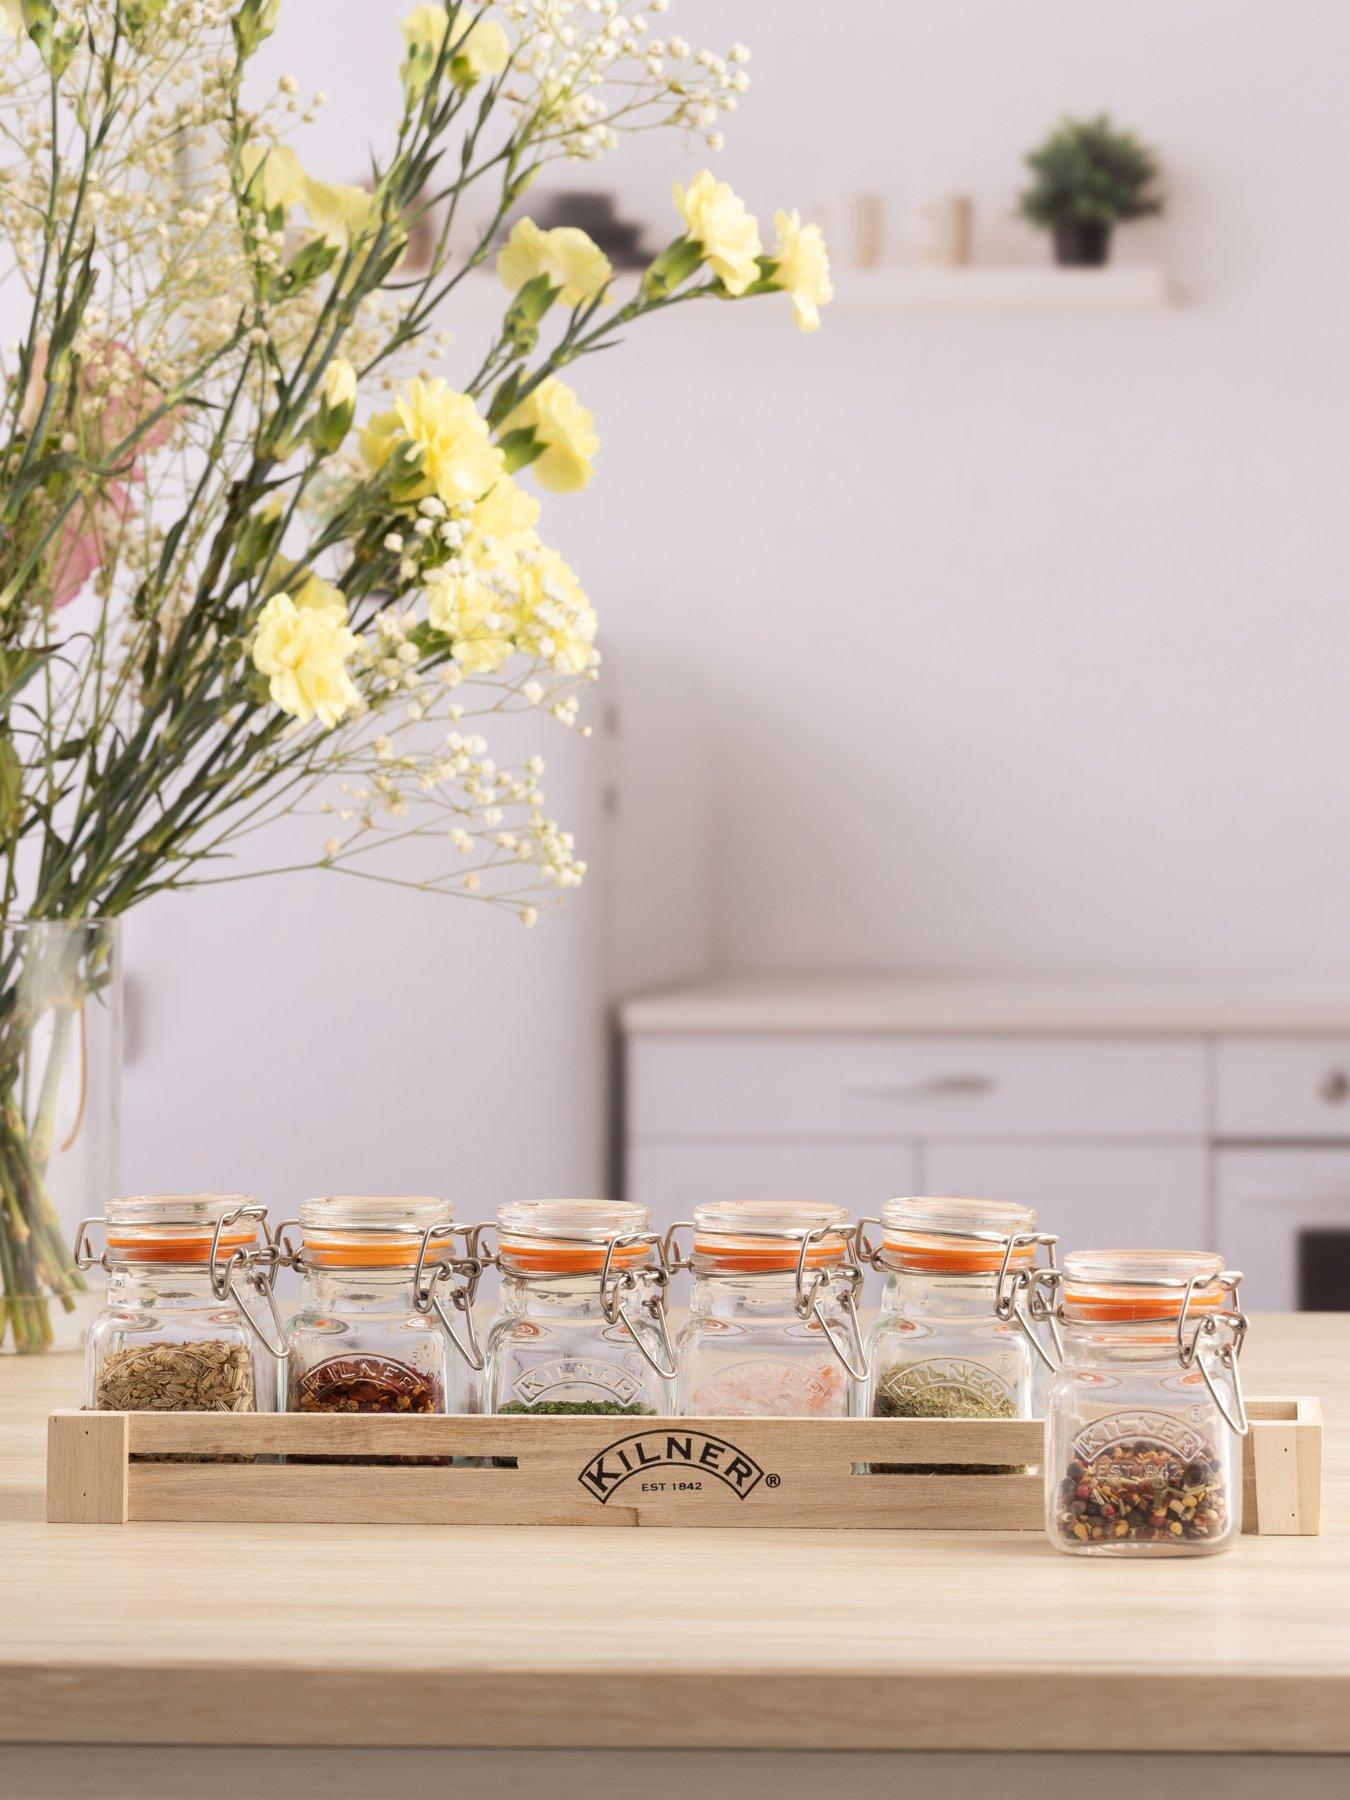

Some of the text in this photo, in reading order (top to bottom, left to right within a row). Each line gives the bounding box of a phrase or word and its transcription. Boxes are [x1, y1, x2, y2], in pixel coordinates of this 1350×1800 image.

[892, 1363, 1000, 1398] KILNER
[1079, 1416, 1200, 1455] KILNER
[585, 1436, 753, 1493] KILNER
[642, 1482, 702, 1491] EST 1842
